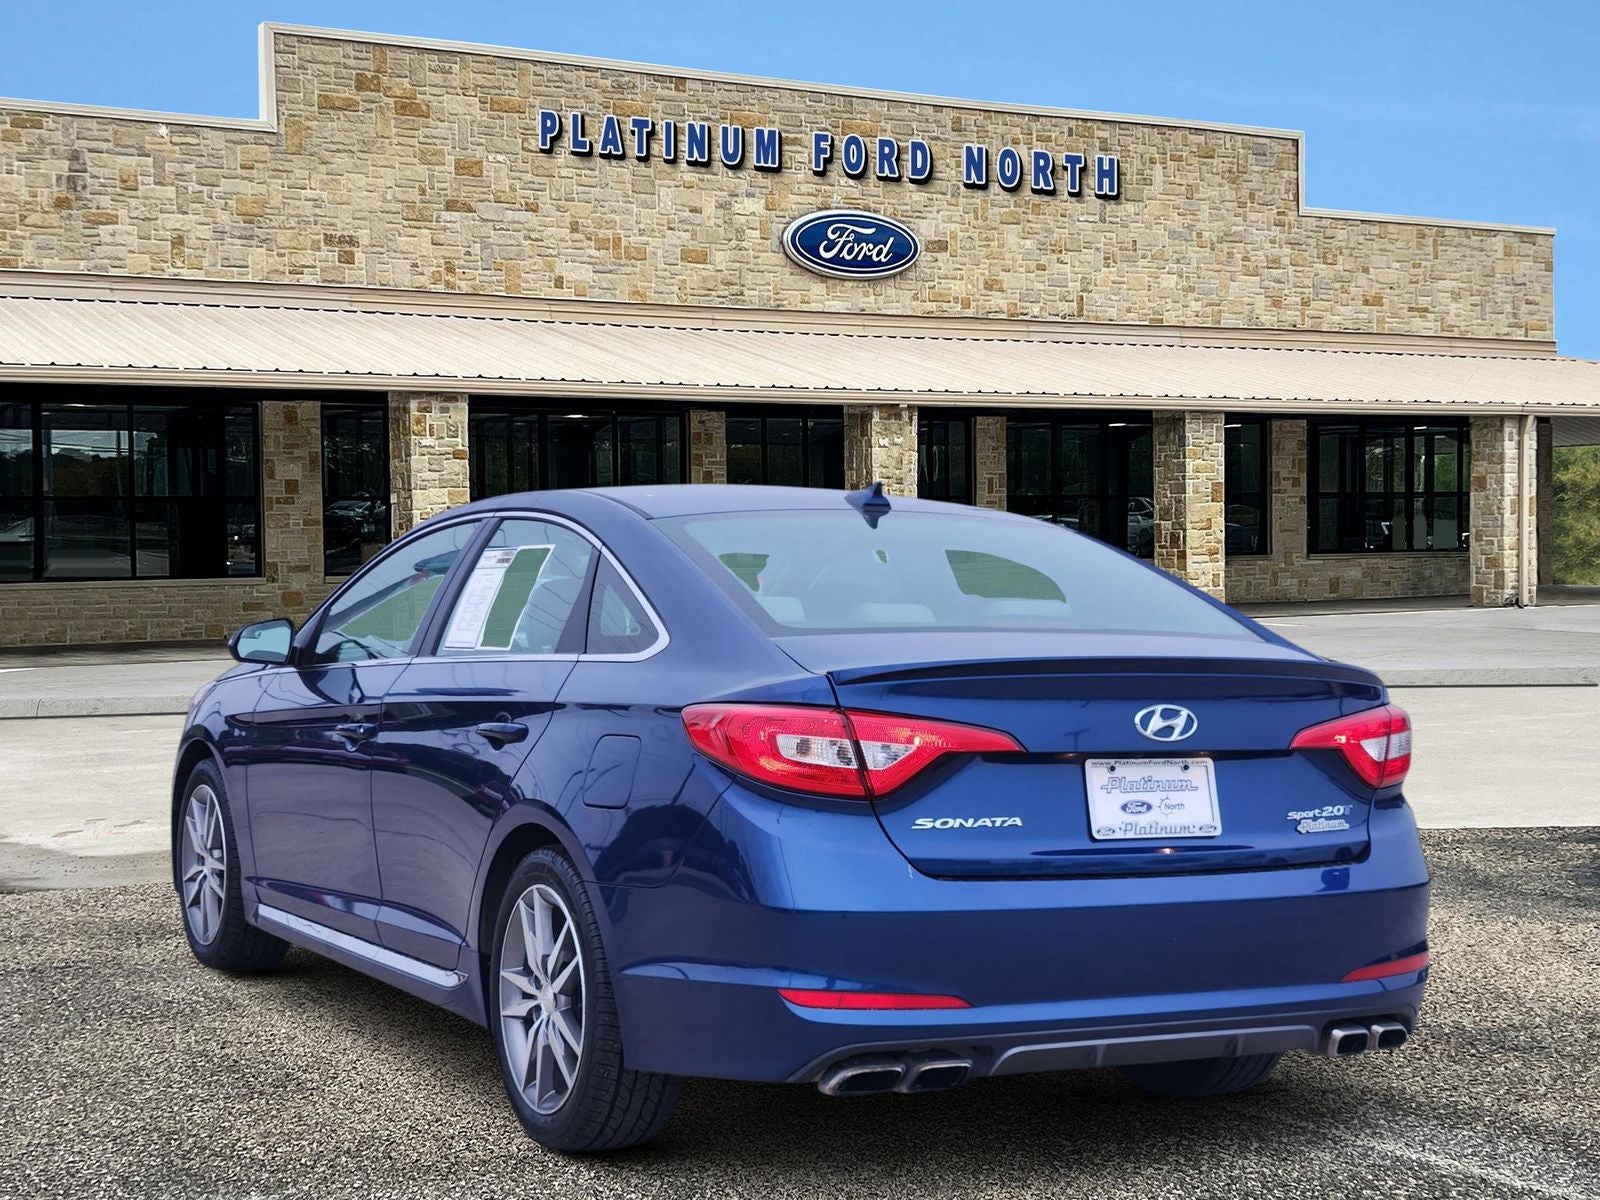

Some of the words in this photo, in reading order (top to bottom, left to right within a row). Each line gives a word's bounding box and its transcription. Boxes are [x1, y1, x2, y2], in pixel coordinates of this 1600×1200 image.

[539, 110, 782, 172] PLATINUM
[812, 133, 933, 185] FORD
[964, 144, 1121, 199] NORTH
[819, 223, 894, 263] Ford
[1100, 775, 1199, 794] Platinum
[1164, 802, 1185, 811] North
[911, 817, 1023, 830] SONATA
[1121, 821, 1196, 836] Platinum
